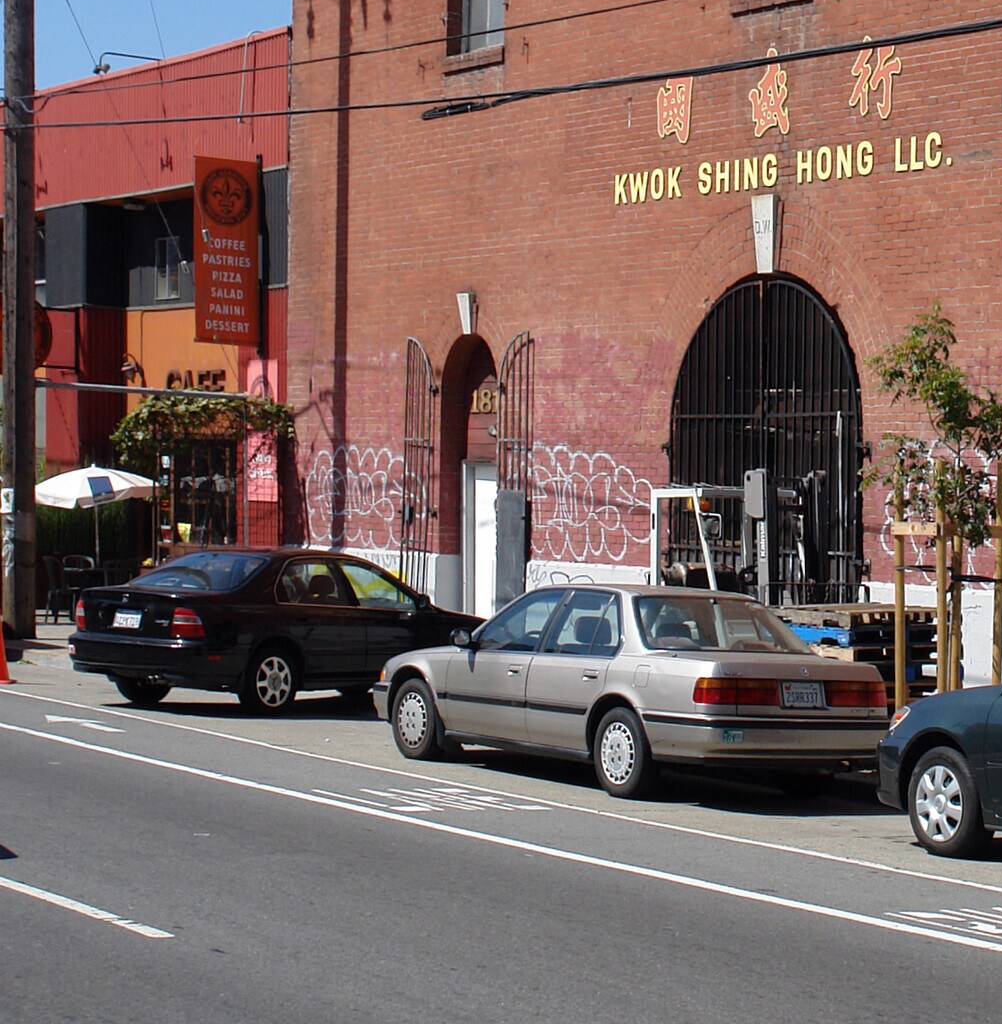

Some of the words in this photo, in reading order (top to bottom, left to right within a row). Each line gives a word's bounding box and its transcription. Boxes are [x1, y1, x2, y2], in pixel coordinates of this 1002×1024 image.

[614, 166, 682, 205] KWOK
[698, 154, 778, 195] SHING
[797, 141, 874, 184] HONG
[895, 132, 953, 172] LLC.
[209, 238, 246, 252] COFFEE
[202, 253, 251, 268] PASTRIES
[212, 270, 242, 283] PIZZA
[210, 287, 244, 300] SALAD
[209, 303, 245, 316] PANINI
[205, 319, 250, 333] DESSERT
